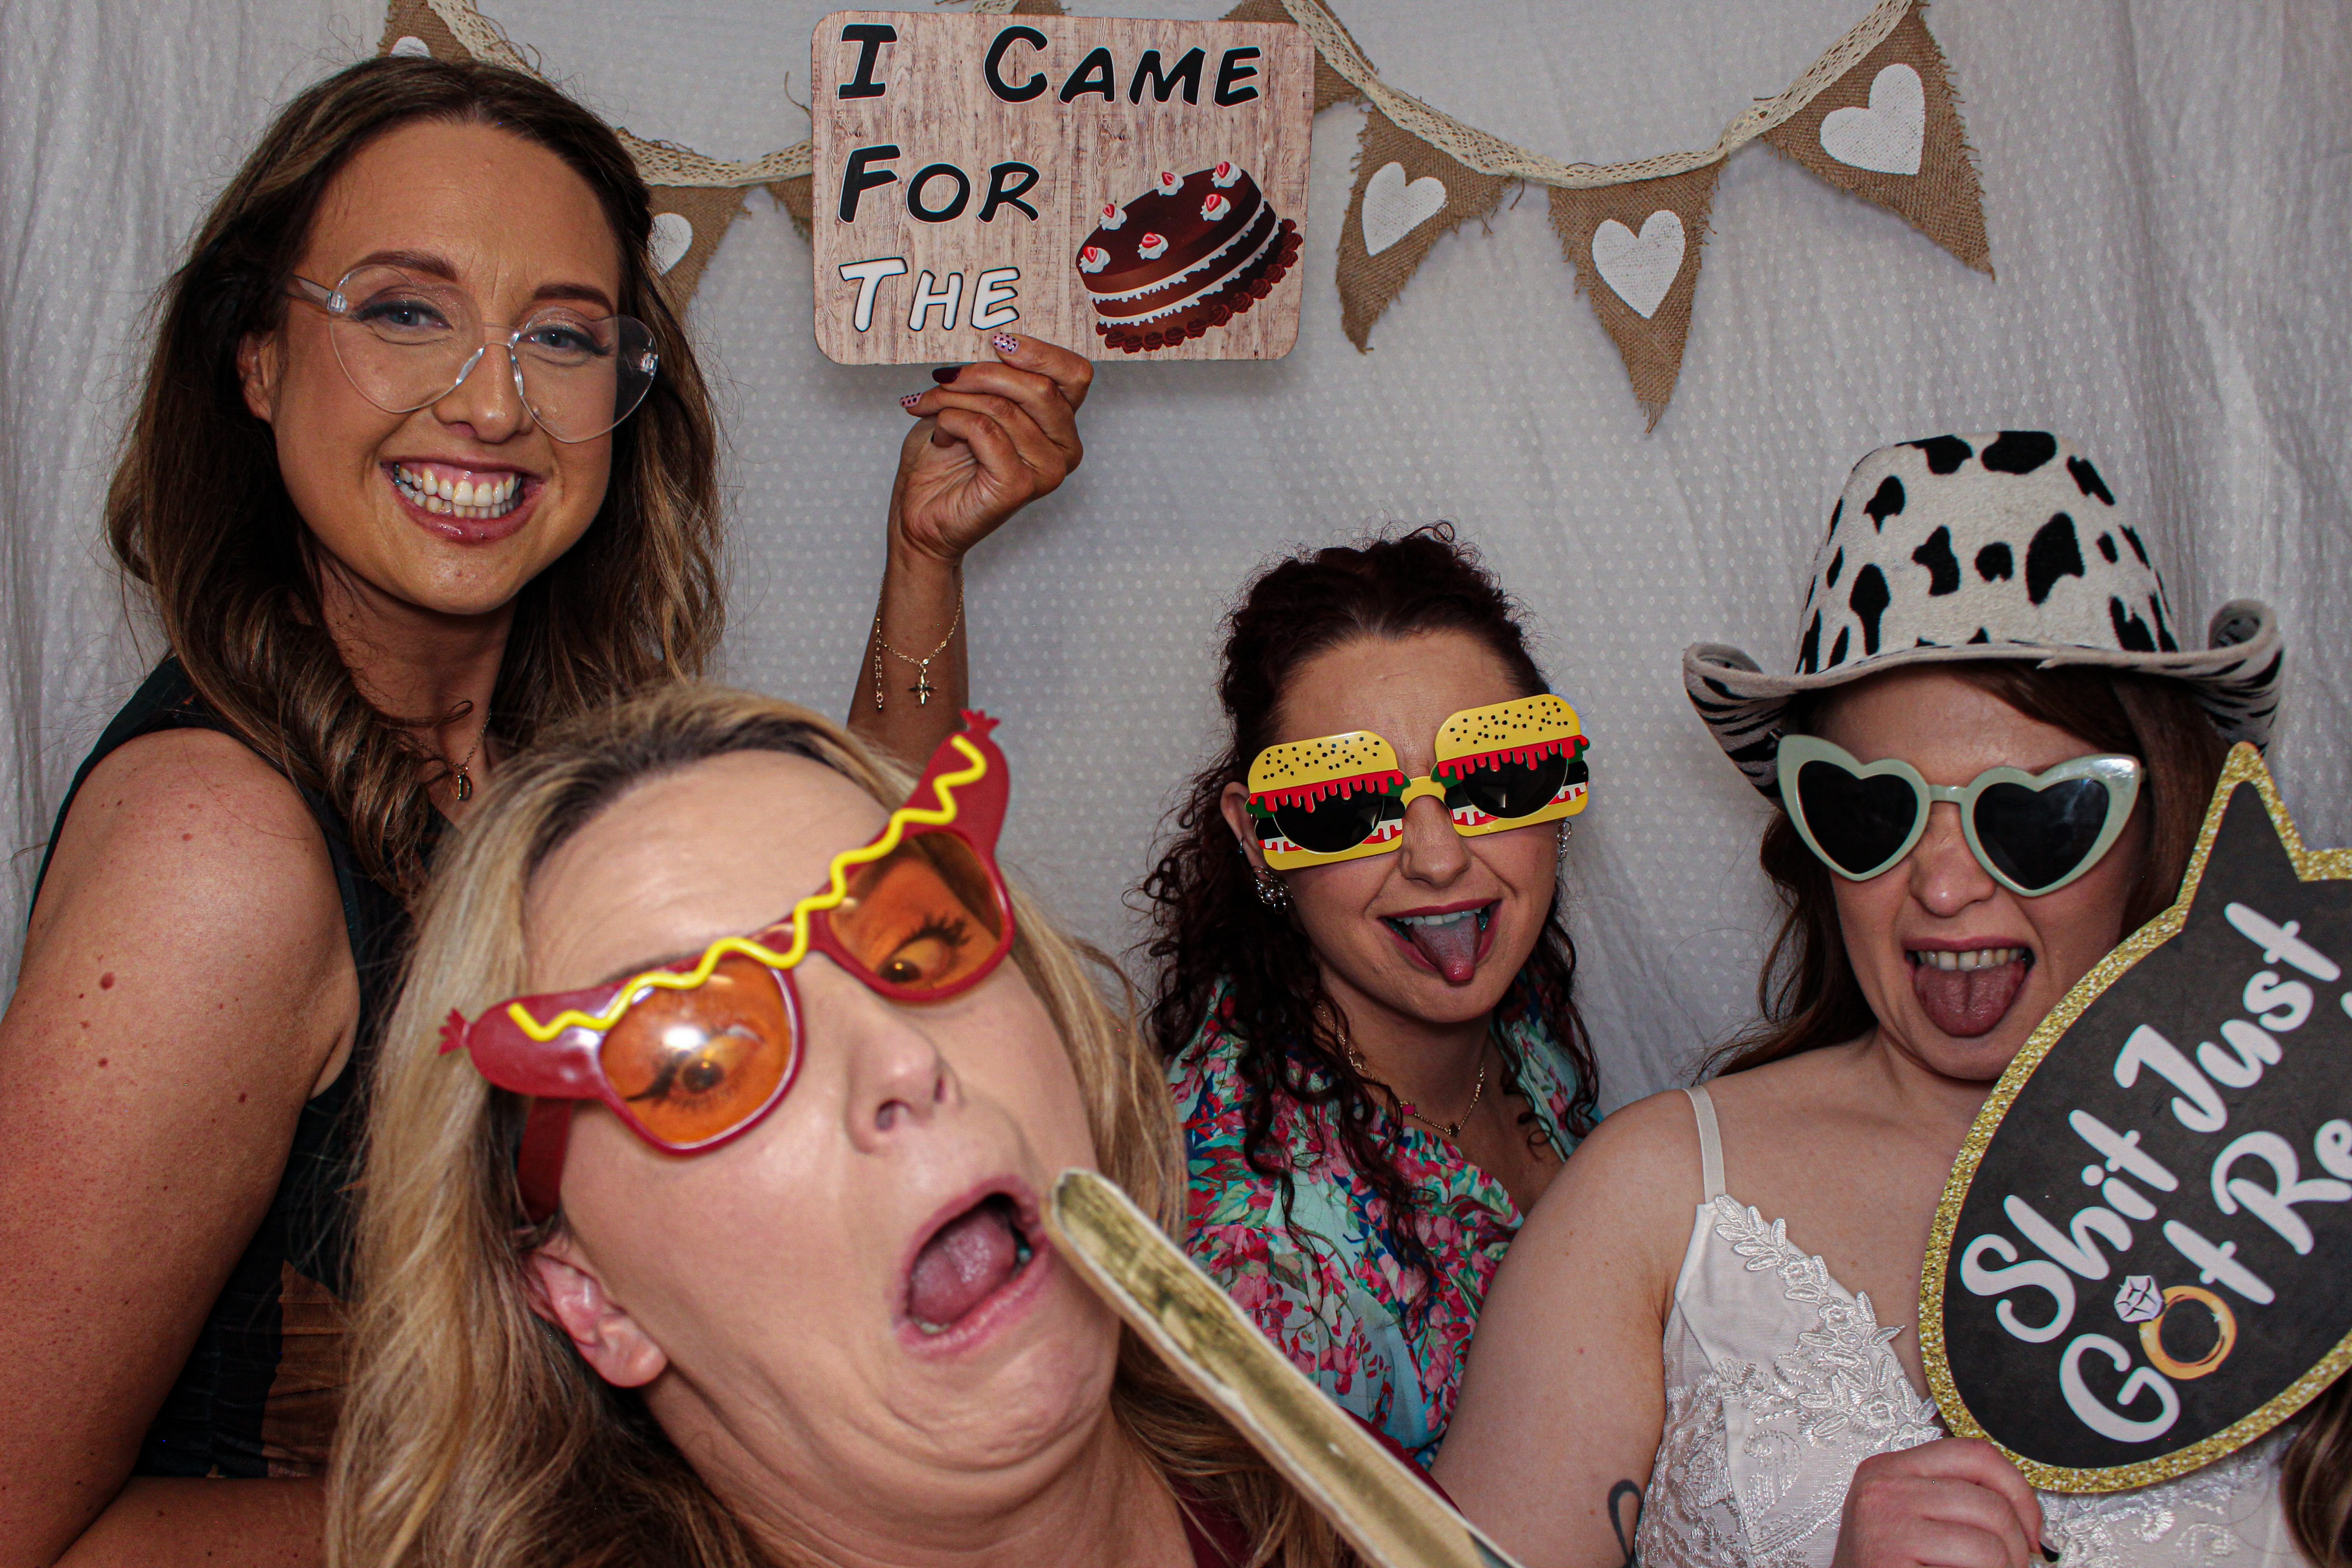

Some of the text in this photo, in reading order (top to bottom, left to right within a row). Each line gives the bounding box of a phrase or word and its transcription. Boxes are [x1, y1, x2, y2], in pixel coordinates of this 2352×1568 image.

[838, 24, 1261, 108] I CAME
[838, 144, 1040, 224] FOR
[838, 257, 1020, 332] THE
[1960, 902, 2341, 1343] Shit Just
